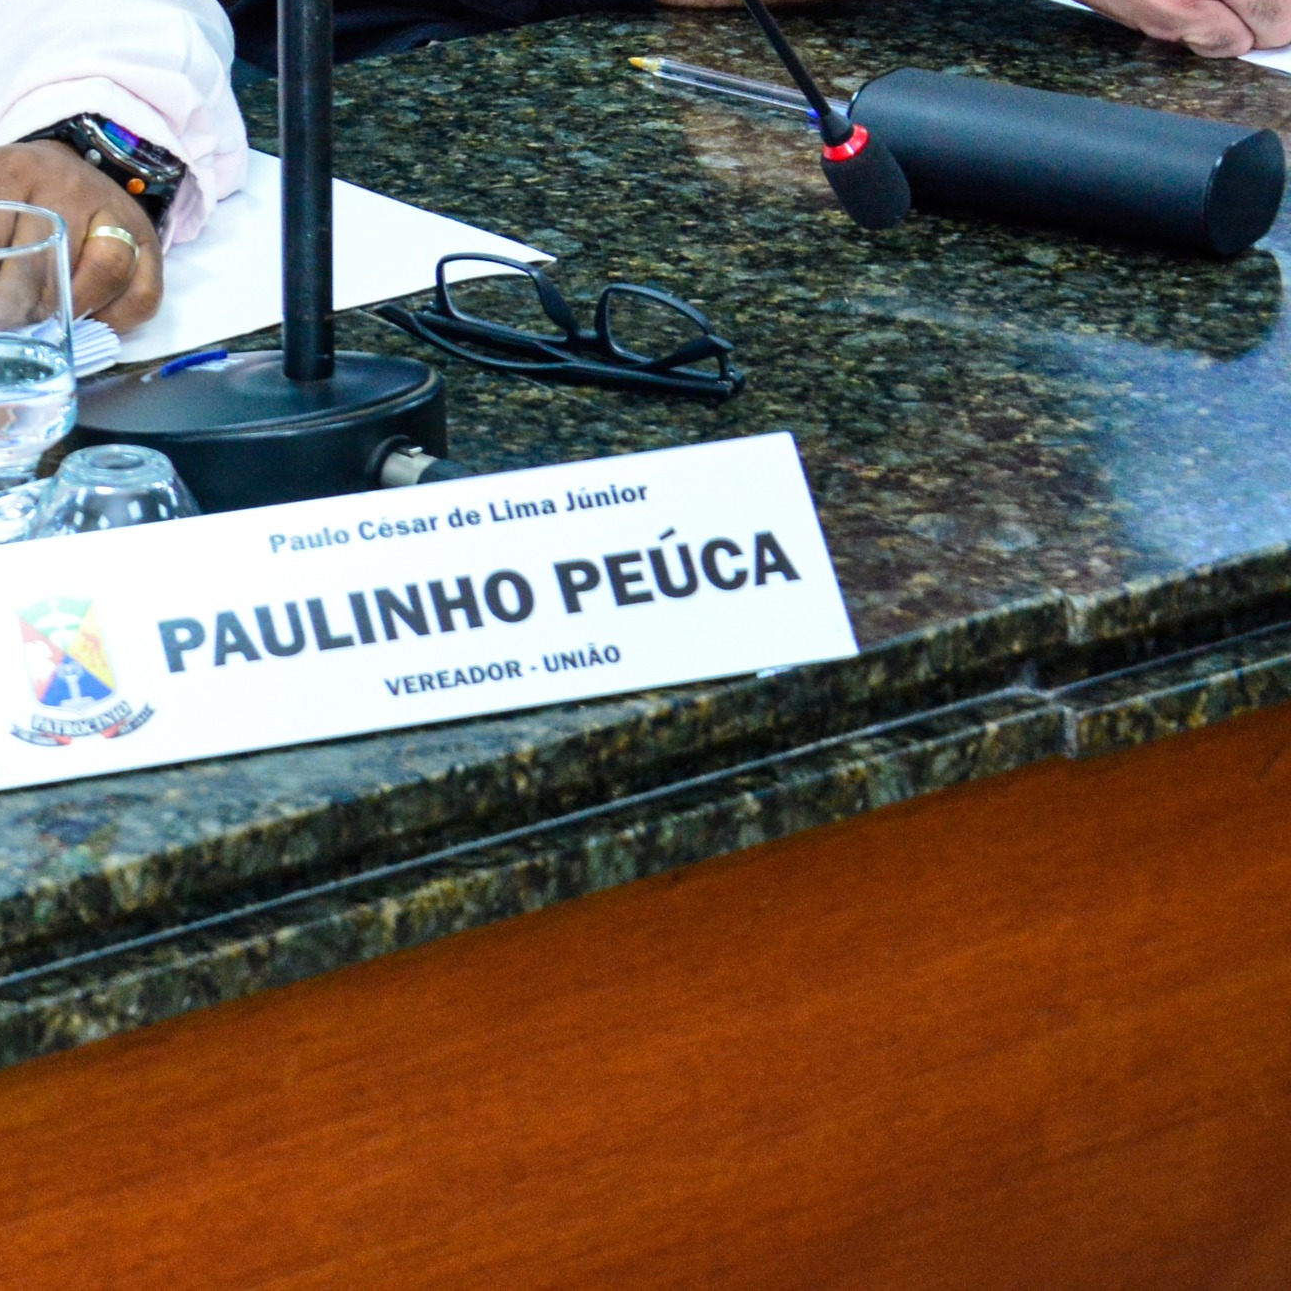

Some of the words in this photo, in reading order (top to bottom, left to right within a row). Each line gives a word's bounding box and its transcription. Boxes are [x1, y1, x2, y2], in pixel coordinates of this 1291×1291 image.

[268, 527, 350, 554] Paulo
[358, 511, 439, 541] César
[448, 507, 481, 528] de
[489, 498, 558, 522] Lima
[566, 484, 648, 512] Júnior
[158, 569, 536, 674] PAULINHO
[552, 528, 802, 615] PEÚCA
[384, 660, 523, 697] VEREADOR
[542, 643, 622, 674] UNIÃO
